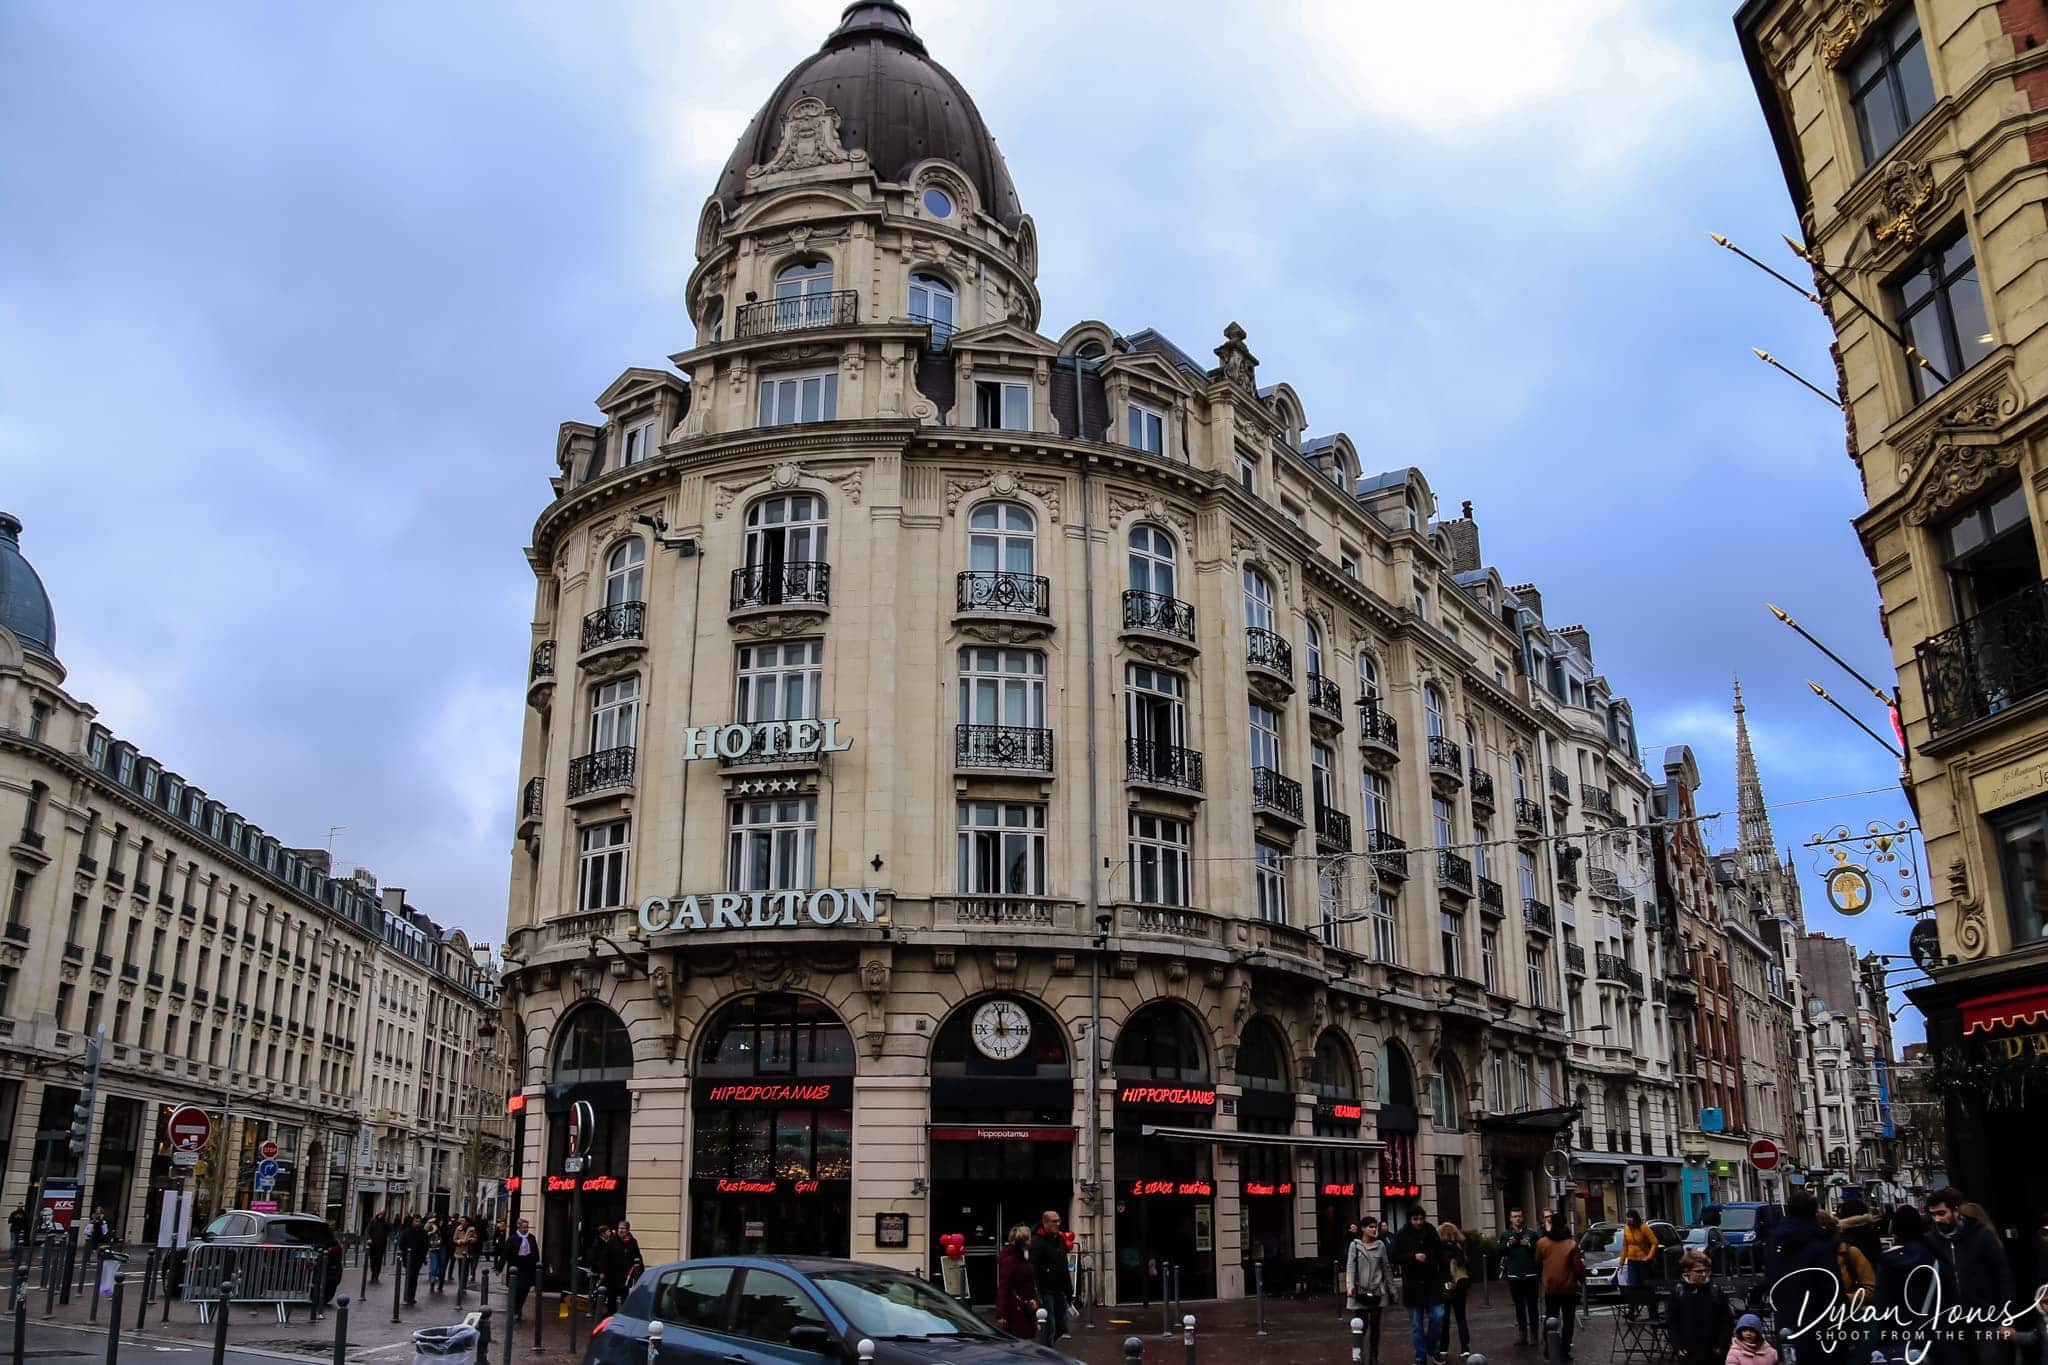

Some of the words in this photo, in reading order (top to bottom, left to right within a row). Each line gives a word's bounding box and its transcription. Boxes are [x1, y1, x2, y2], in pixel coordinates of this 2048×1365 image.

[682, 718, 854, 760] HOTEL
[638, 887, 881, 932] CARLTON
[709, 1085, 831, 1101] HIPPOPOTAMUS
[1121, 1087, 1216, 1106] HIPPOPOTAMUS
[977, 1129, 1030, 1139] hippopotamus
[54, 1200, 75, 1209] KFC
